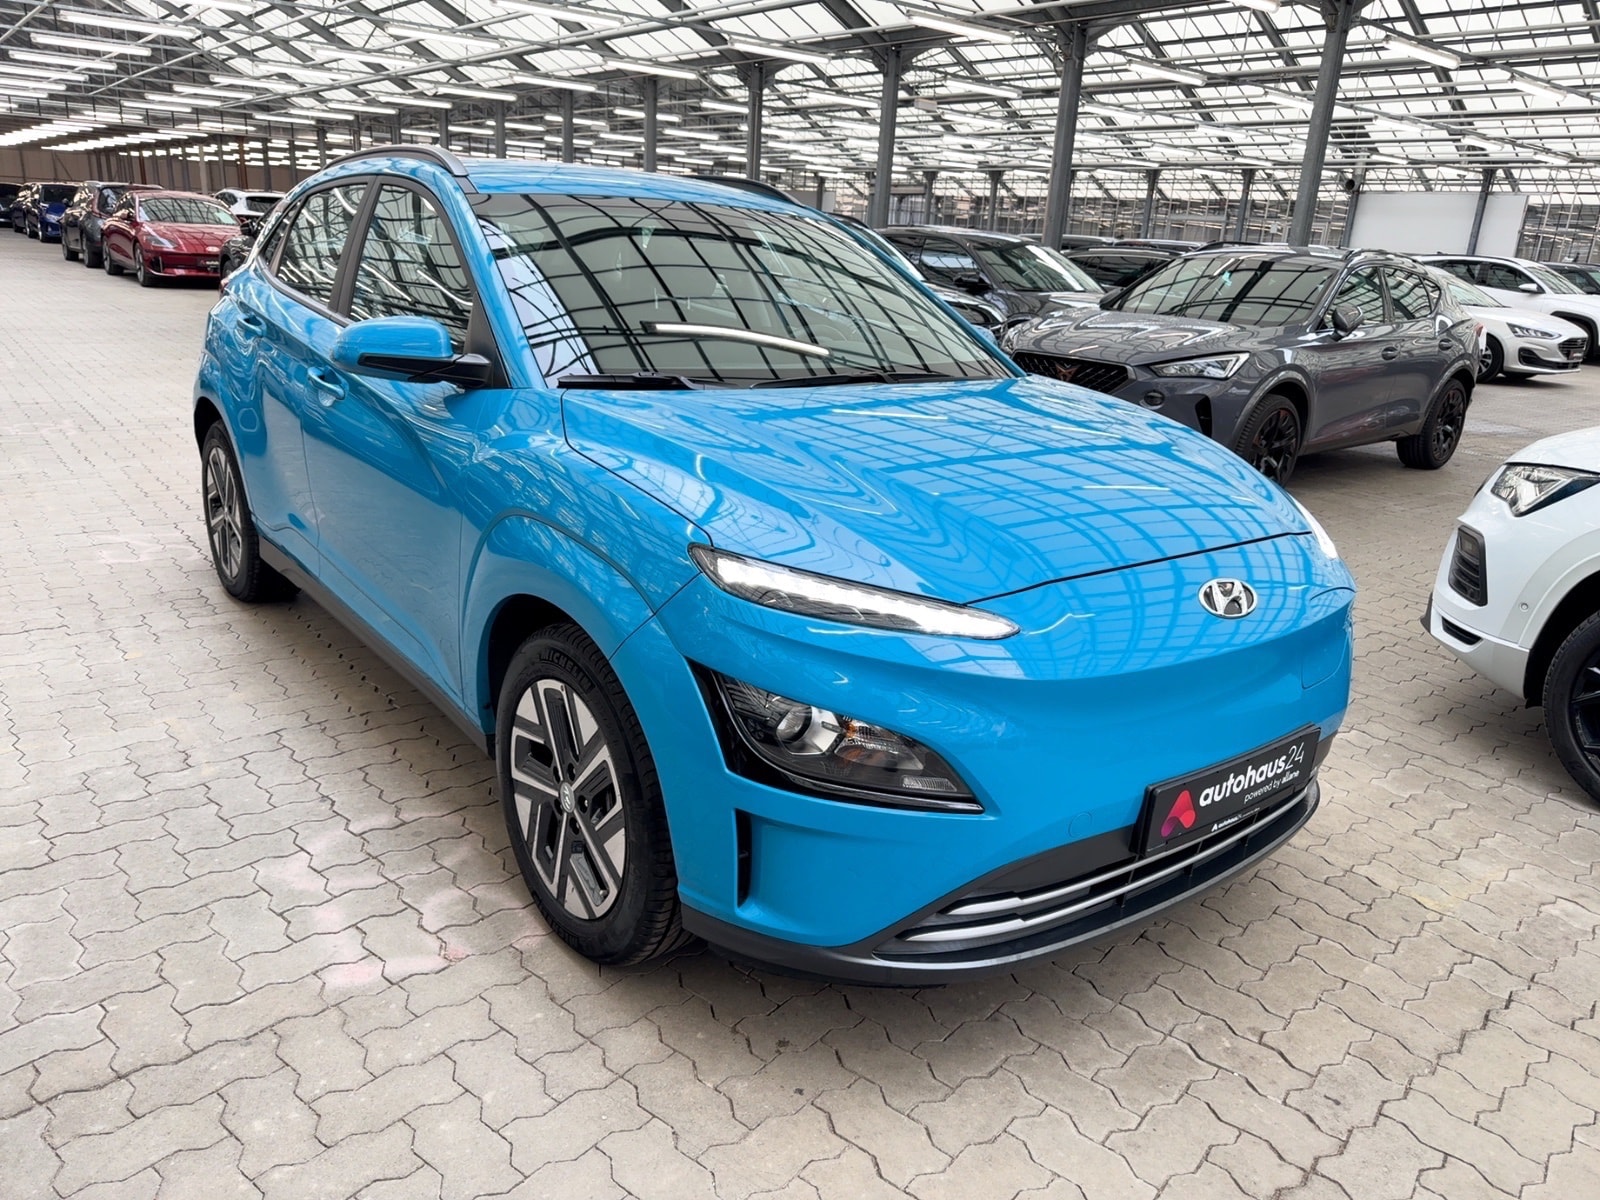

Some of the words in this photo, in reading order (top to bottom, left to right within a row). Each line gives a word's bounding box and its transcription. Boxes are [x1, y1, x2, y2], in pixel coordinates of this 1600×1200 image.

[540, 649, 595, 691] MICHELIN
[1200, 742, 1305, 807] autohaus24
[1244, 780, 1273, 804] powered
[1273, 779, 1281, 789] by
